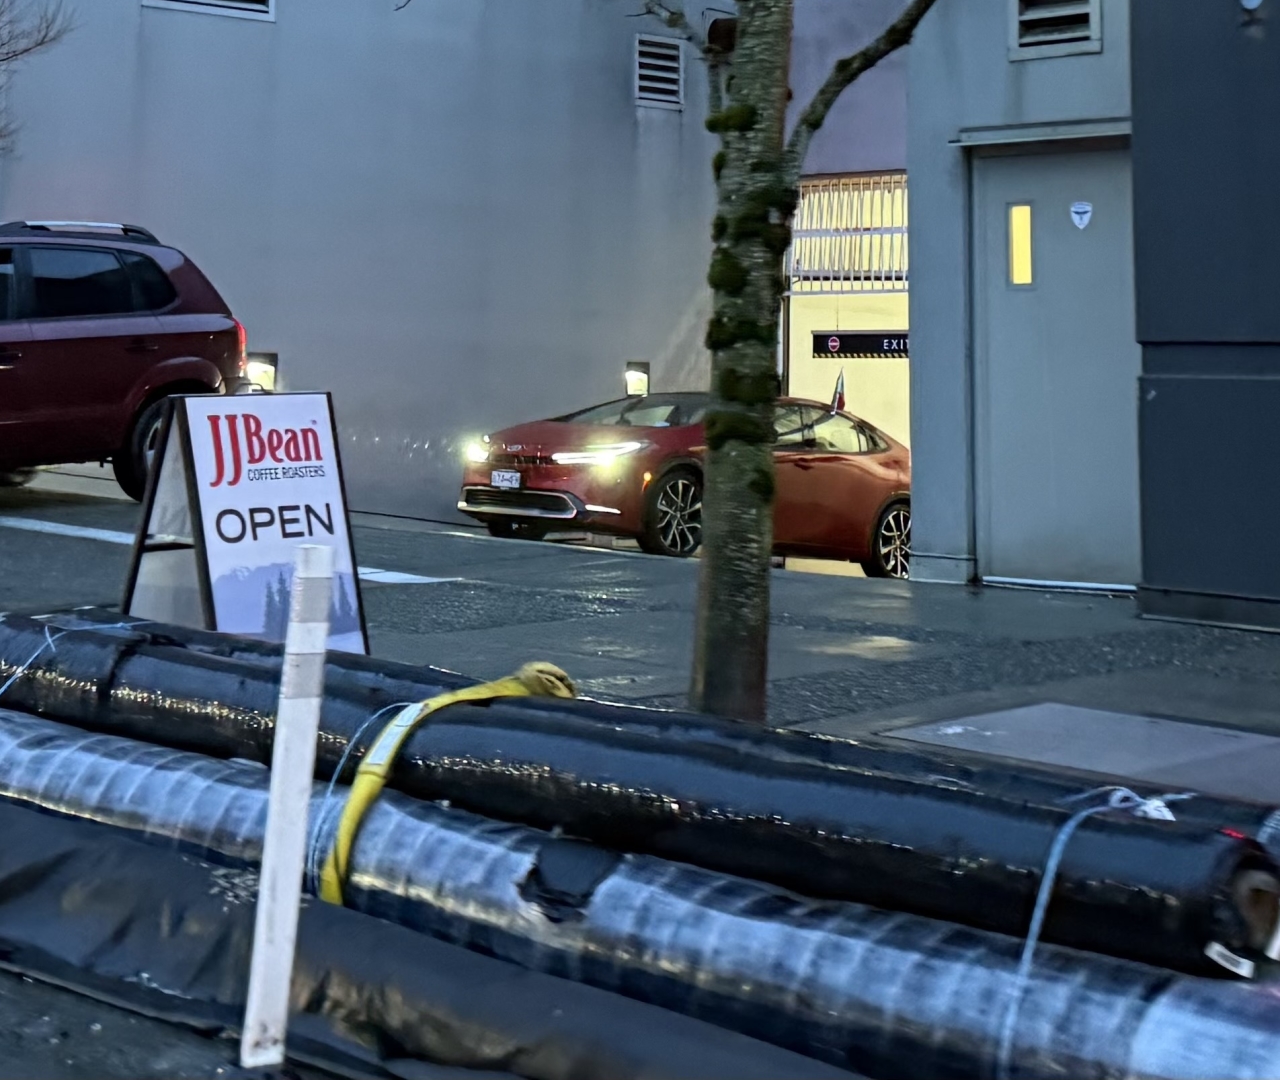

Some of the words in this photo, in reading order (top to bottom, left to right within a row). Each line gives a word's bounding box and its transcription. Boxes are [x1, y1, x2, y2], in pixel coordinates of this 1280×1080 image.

[247, 467, 280, 481] COFFEE
[282, 465, 326, 479] ROASTERS
[215, 503, 335, 544] OPEN
